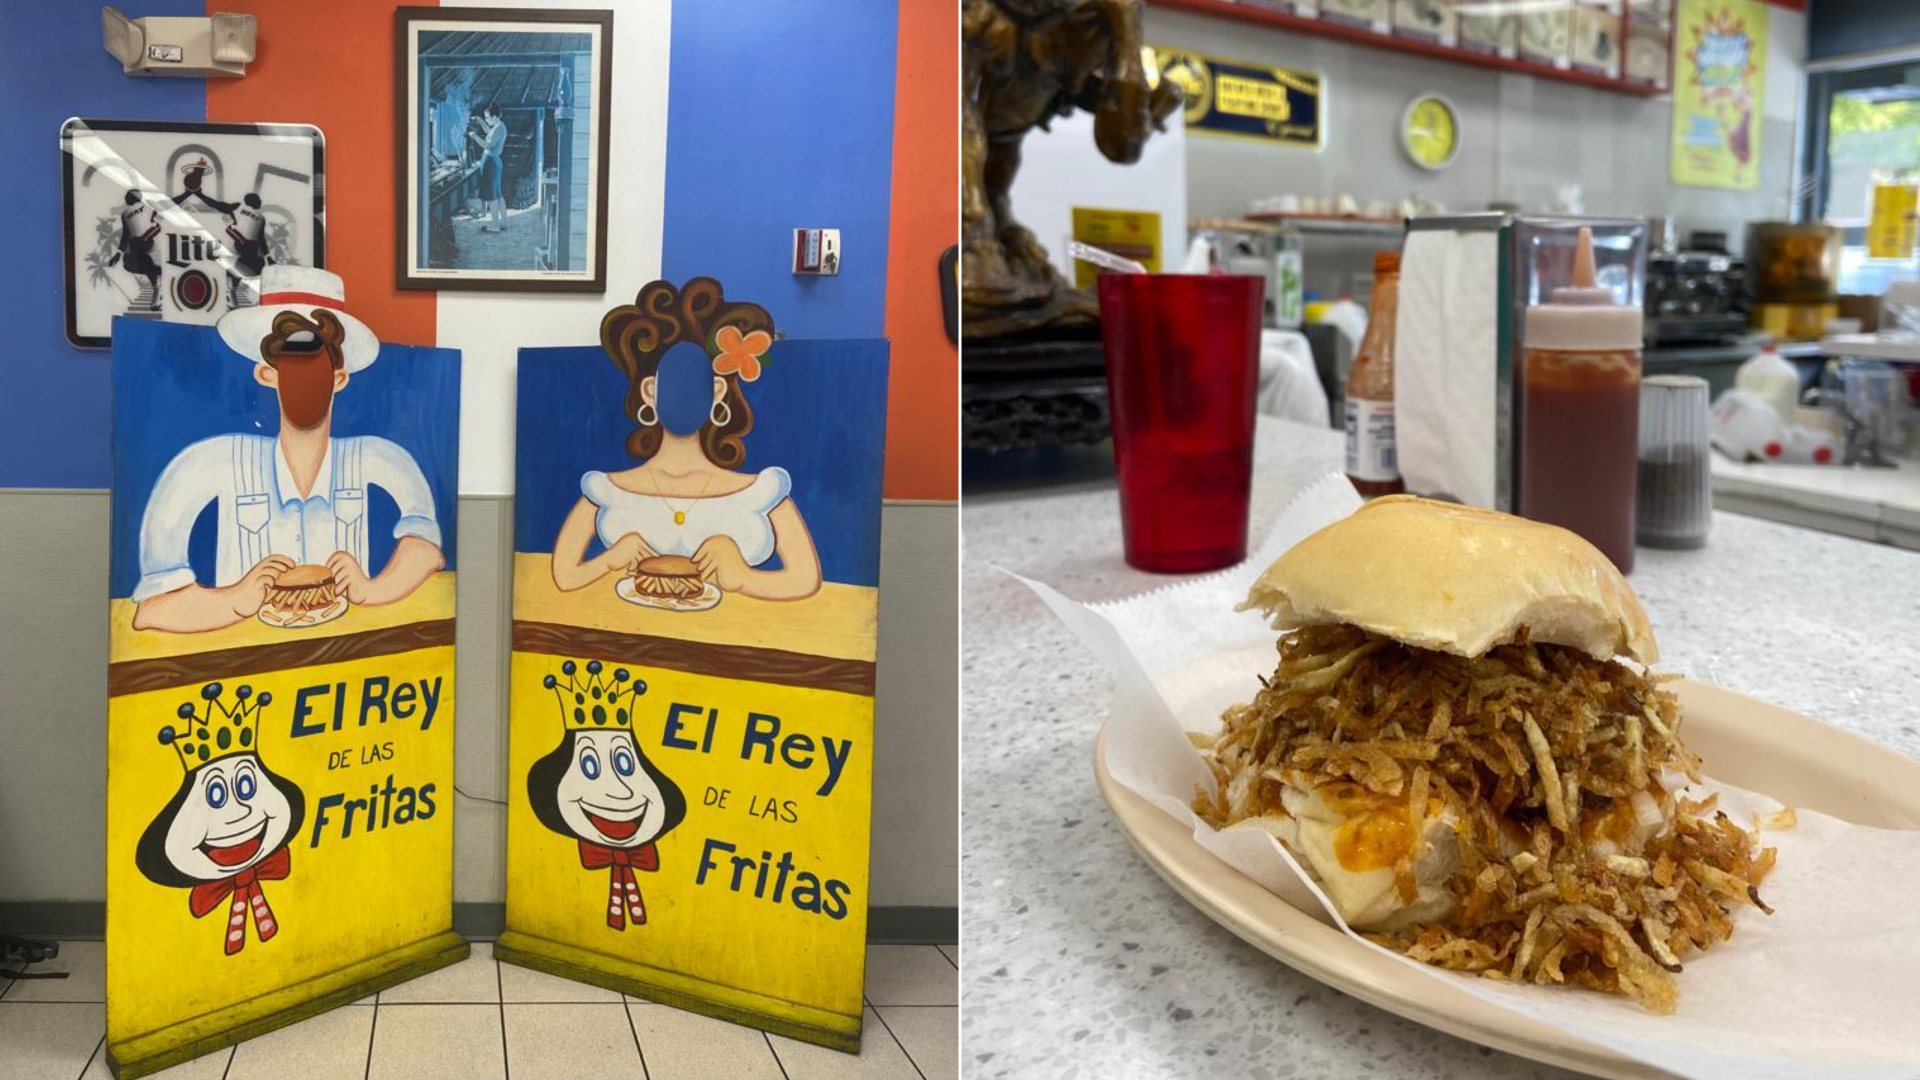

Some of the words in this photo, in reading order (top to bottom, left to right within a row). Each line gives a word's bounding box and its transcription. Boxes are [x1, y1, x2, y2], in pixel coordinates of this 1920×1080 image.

[165, 233, 222, 268] Lite
[290, 682, 347, 739] El
[358, 676, 443, 731] Rey
[328, 749, 351, 771] DE
[361, 742, 394, 765] LAS
[661, 702, 718, 755] El
[740, 712, 853, 797] Rey
[310, 774, 437, 849] Fritas
[703, 786, 731, 809] DE
[749, 795, 798, 824] LAS
[695, 838, 852, 921] Fritas
